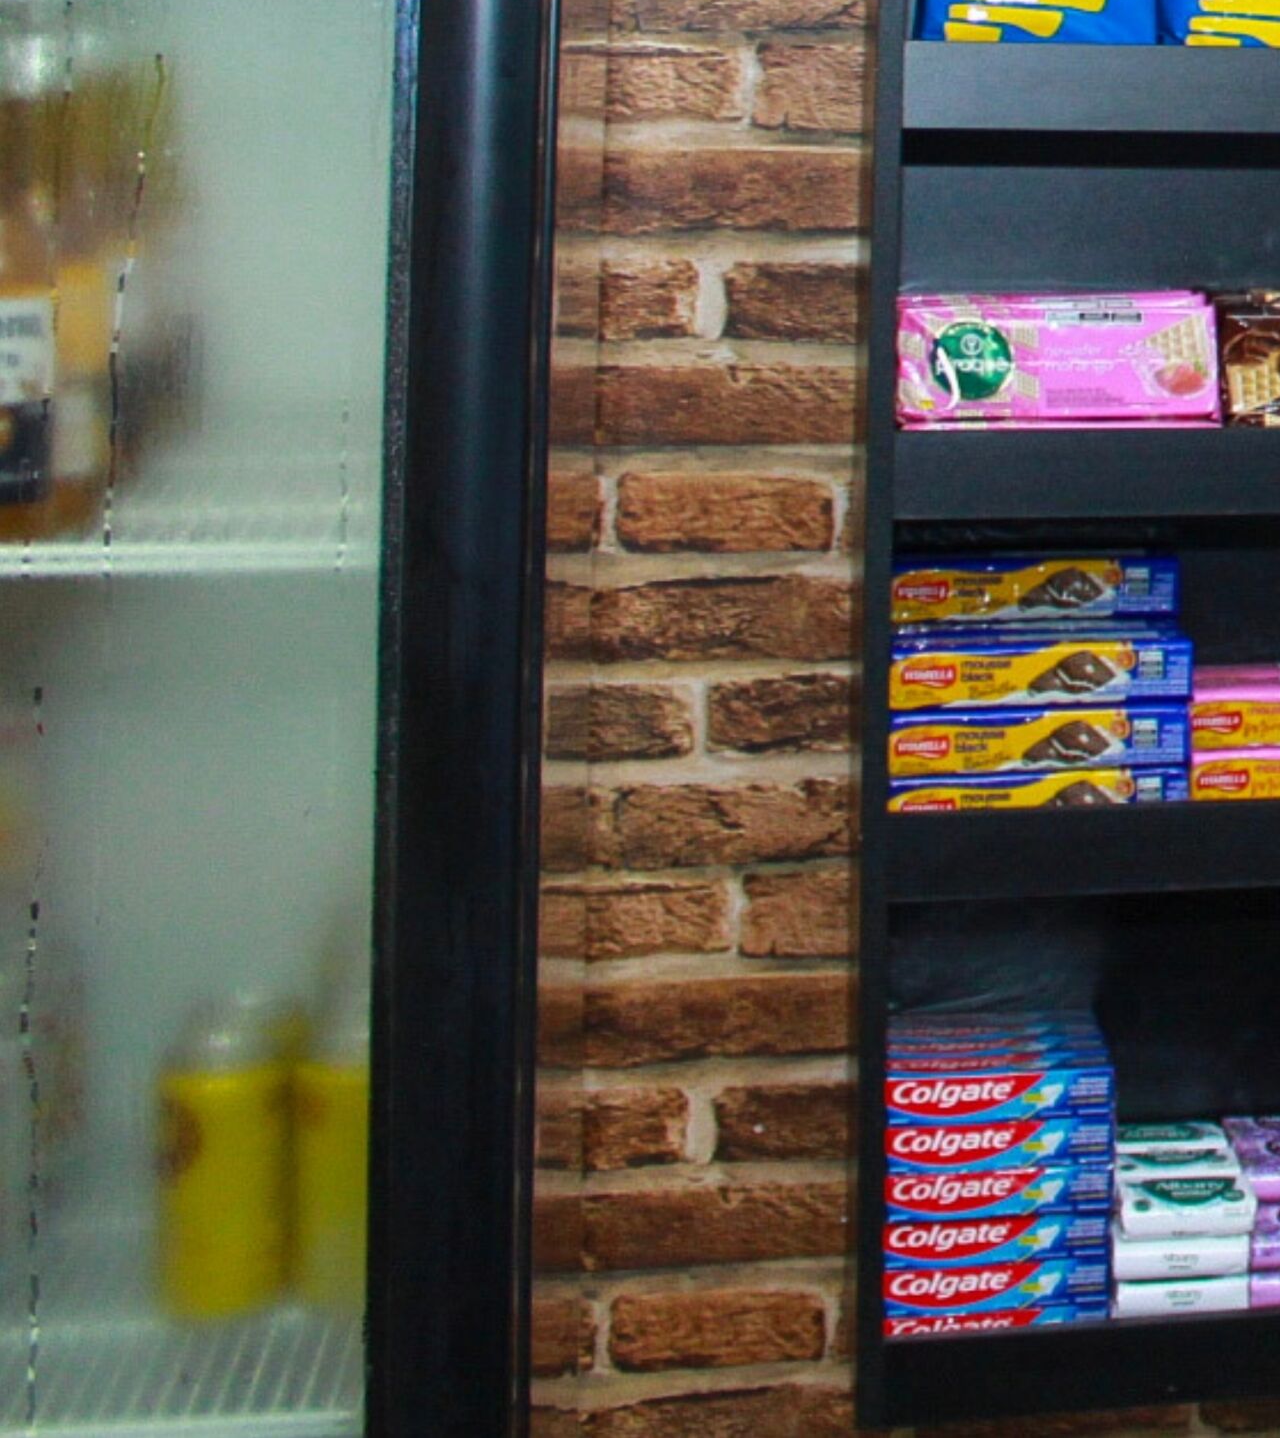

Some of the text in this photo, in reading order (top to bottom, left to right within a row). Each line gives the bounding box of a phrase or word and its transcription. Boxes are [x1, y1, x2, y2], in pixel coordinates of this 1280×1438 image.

[935, 352, 1016, 375] praquê
[892, 1079, 1014, 1109] Colgate
[892, 1128, 1014, 1157] Colgate
[892, 1176, 1013, 1206] Colgate
[889, 1224, 1011, 1253] Colgate
[890, 1270, 1013, 1300] Colgate
